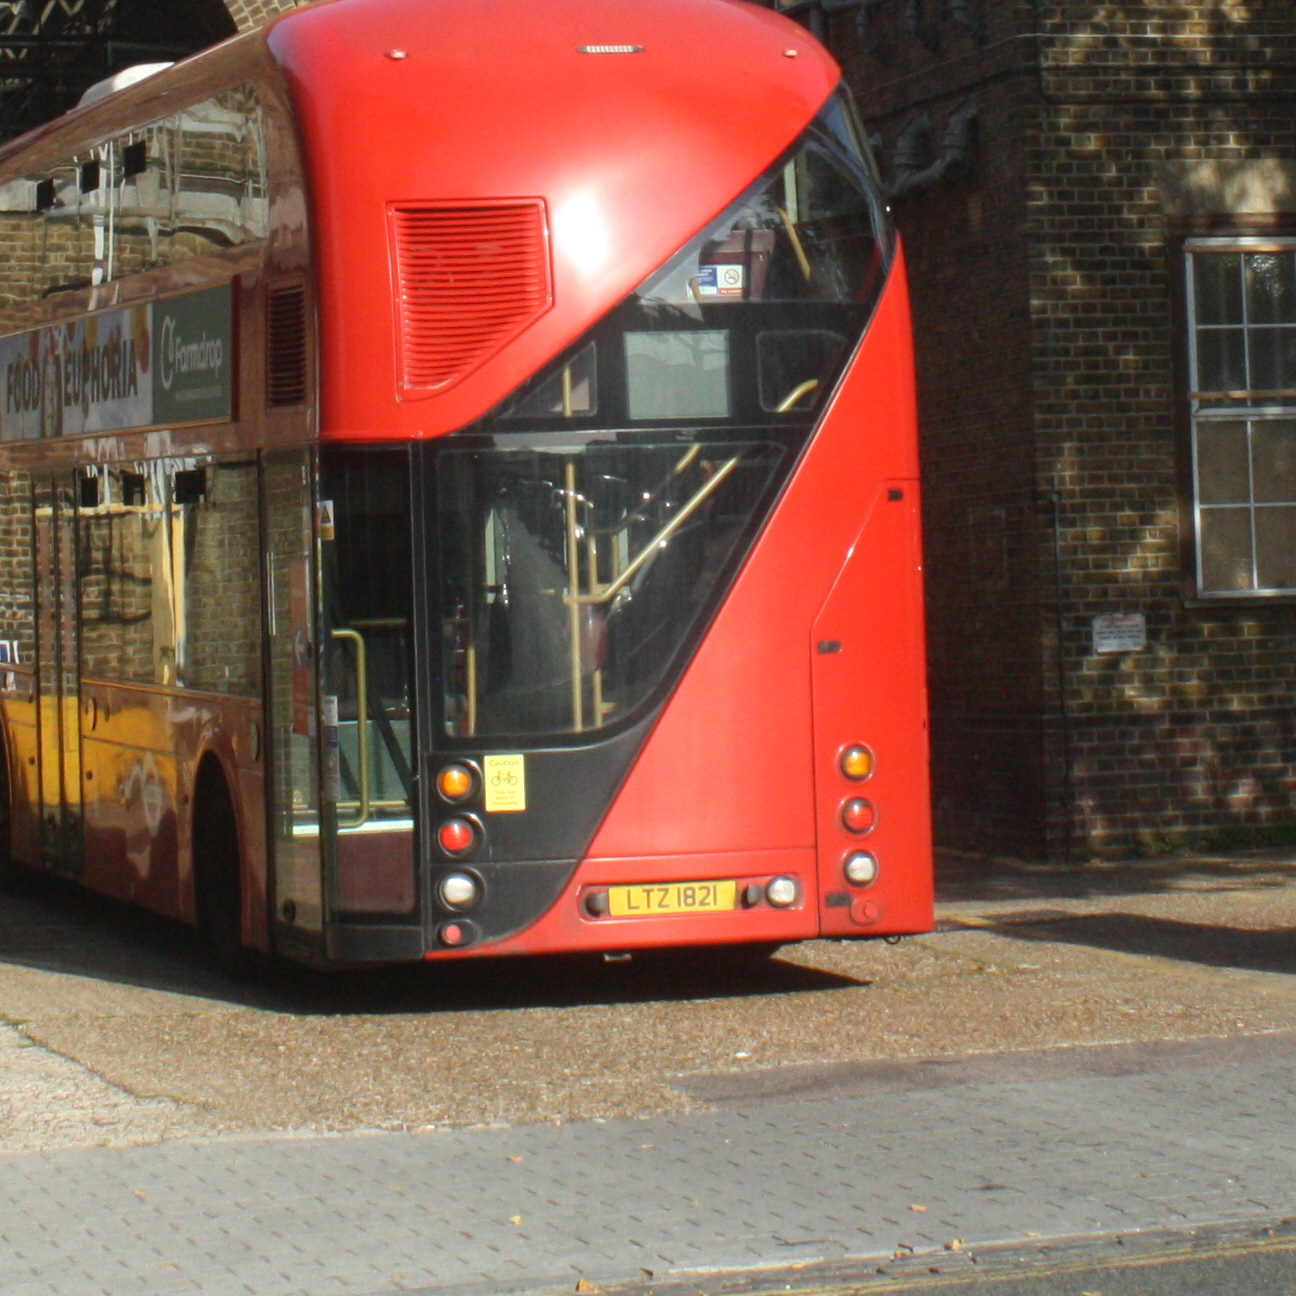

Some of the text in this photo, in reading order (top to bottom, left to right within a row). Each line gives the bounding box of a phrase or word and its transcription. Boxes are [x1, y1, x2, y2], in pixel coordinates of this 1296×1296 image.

[175, 332, 223, 378] Farmdrop
[6, 358, 42, 415] FOOD
[64, 337, 139, 407] EUPHORIA
[489, 759, 520, 767] Caution
[627, 885, 717, 910] LTZ 1821
